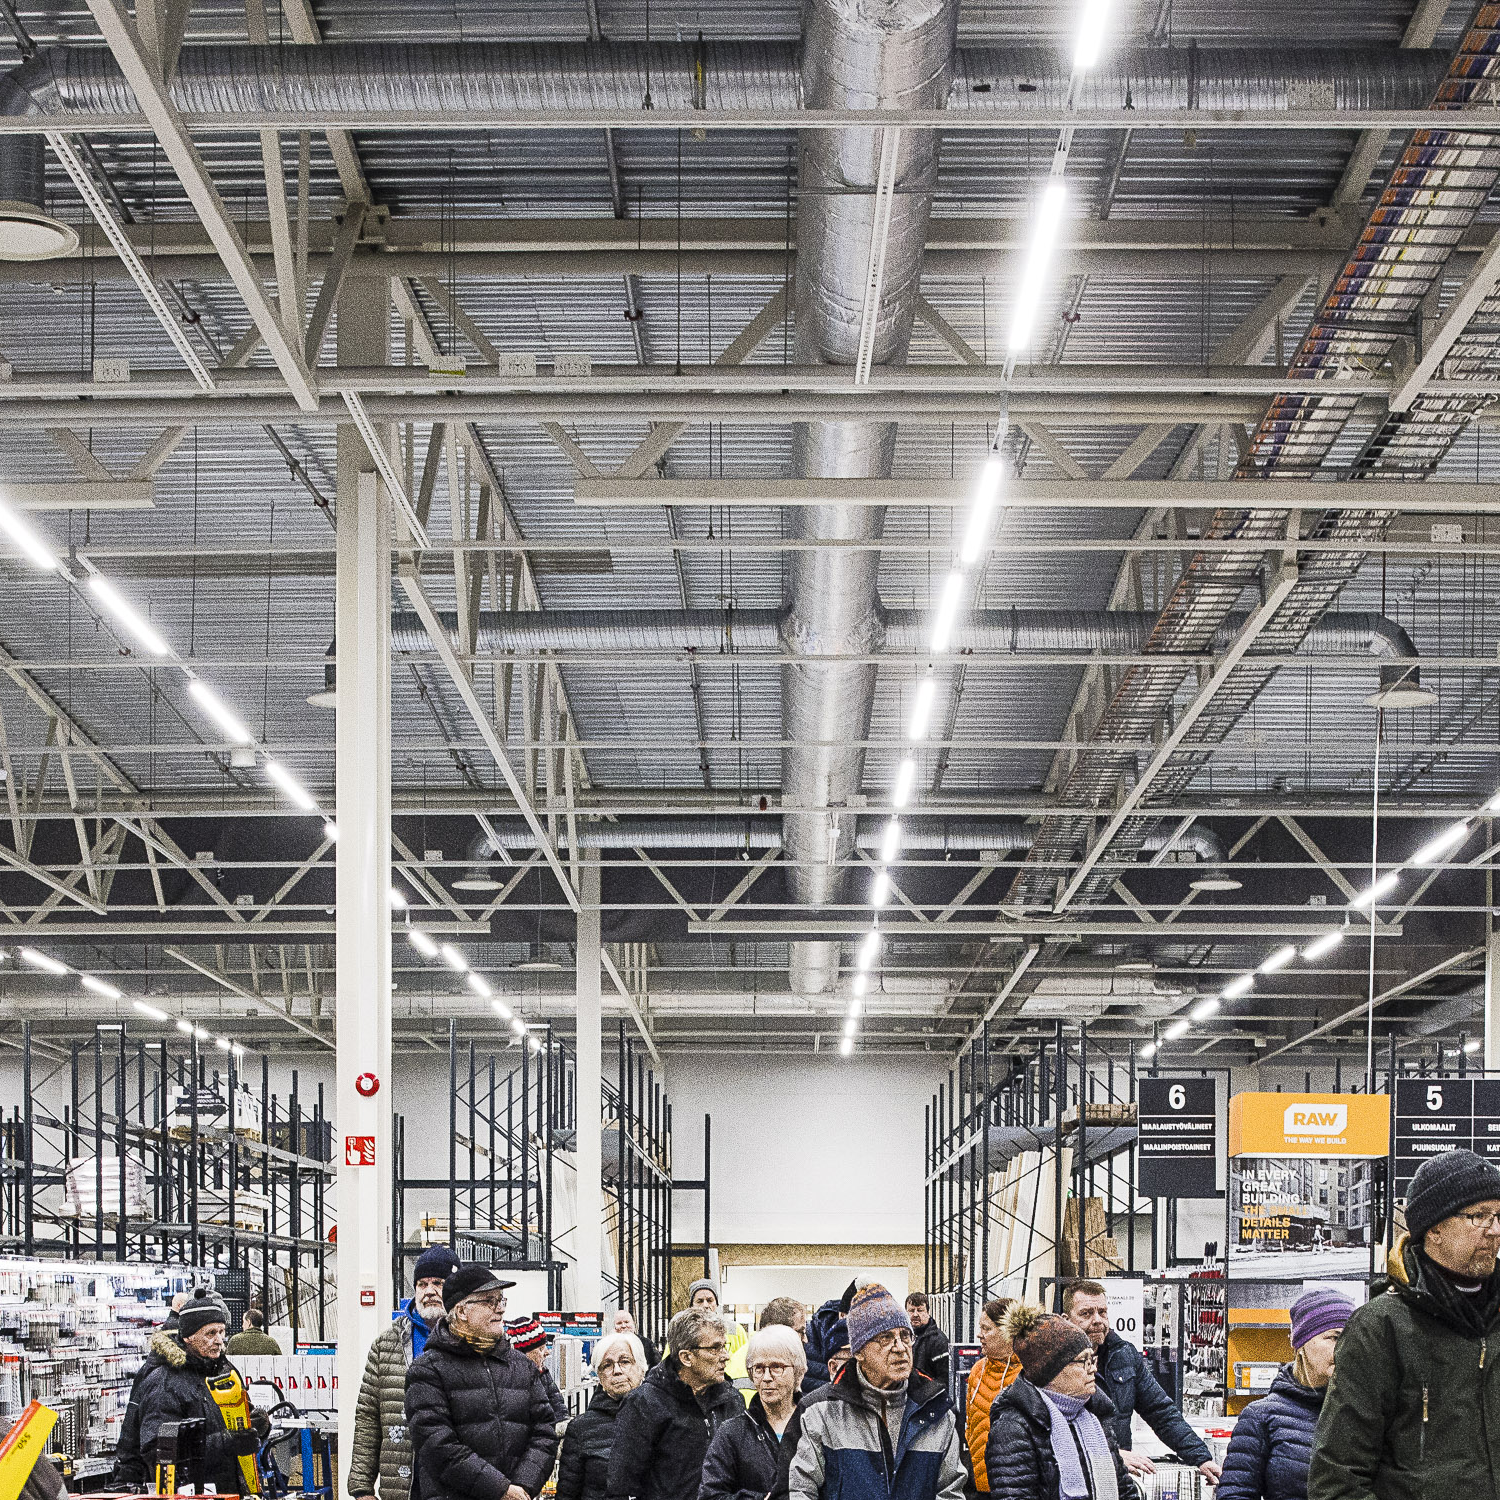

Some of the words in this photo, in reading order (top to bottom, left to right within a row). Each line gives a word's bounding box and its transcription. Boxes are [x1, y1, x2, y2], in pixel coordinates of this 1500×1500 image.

[1168, 1084, 1187, 1110] 6
[1425, 1085, 1443, 1111] 5
[1293, 1112, 1338, 1127] RAW
[1284, 1136, 1298, 1144] THE
[1298, 1136, 1314, 1144] WAY
[1314, 1136, 1325, 1145] WE
[1325, 1136, 1348, 1145] BUILD
[1242, 1169, 1255, 1180] IN
[1258, 1170, 1297, 1181] EVERY
[1241, 1182, 1282, 1192] GREAT
[1241, 1217, 1291, 1228] DETAILS
[1241, 1229, 1290, 1240] MATTER
